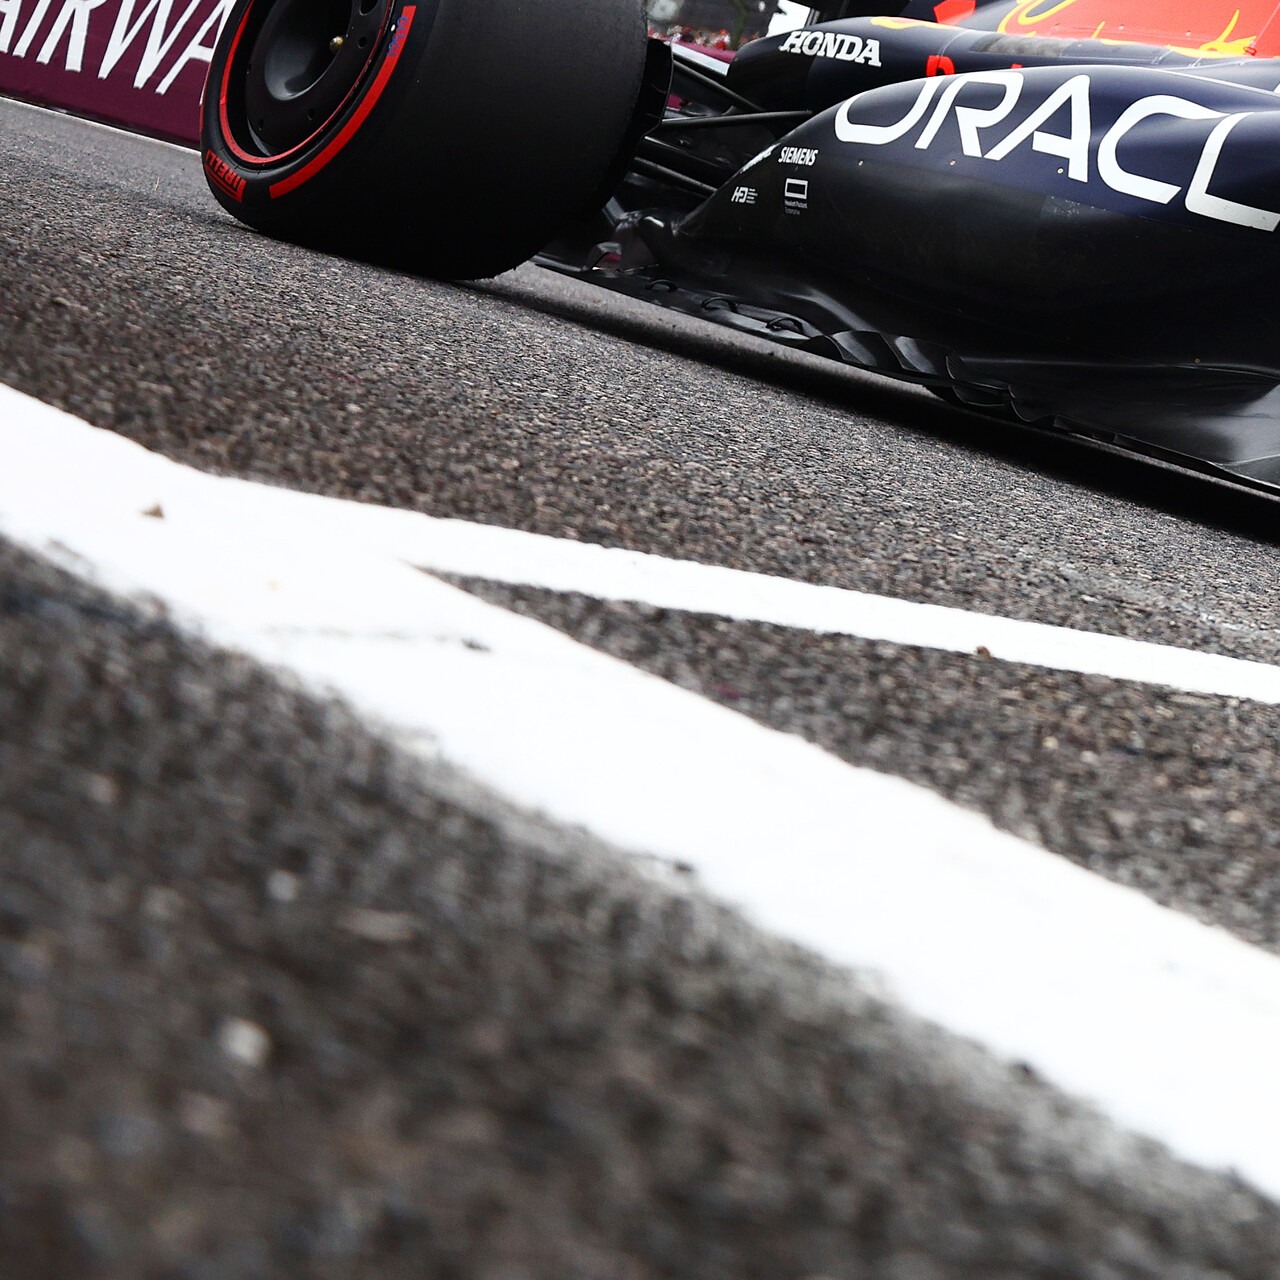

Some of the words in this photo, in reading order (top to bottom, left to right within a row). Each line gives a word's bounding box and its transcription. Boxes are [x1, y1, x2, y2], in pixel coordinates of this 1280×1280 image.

[779, 30, 882, 67] HONDA
[778, 146, 819, 166] SIEMENS
[205, 149, 247, 203] PIRELLI
